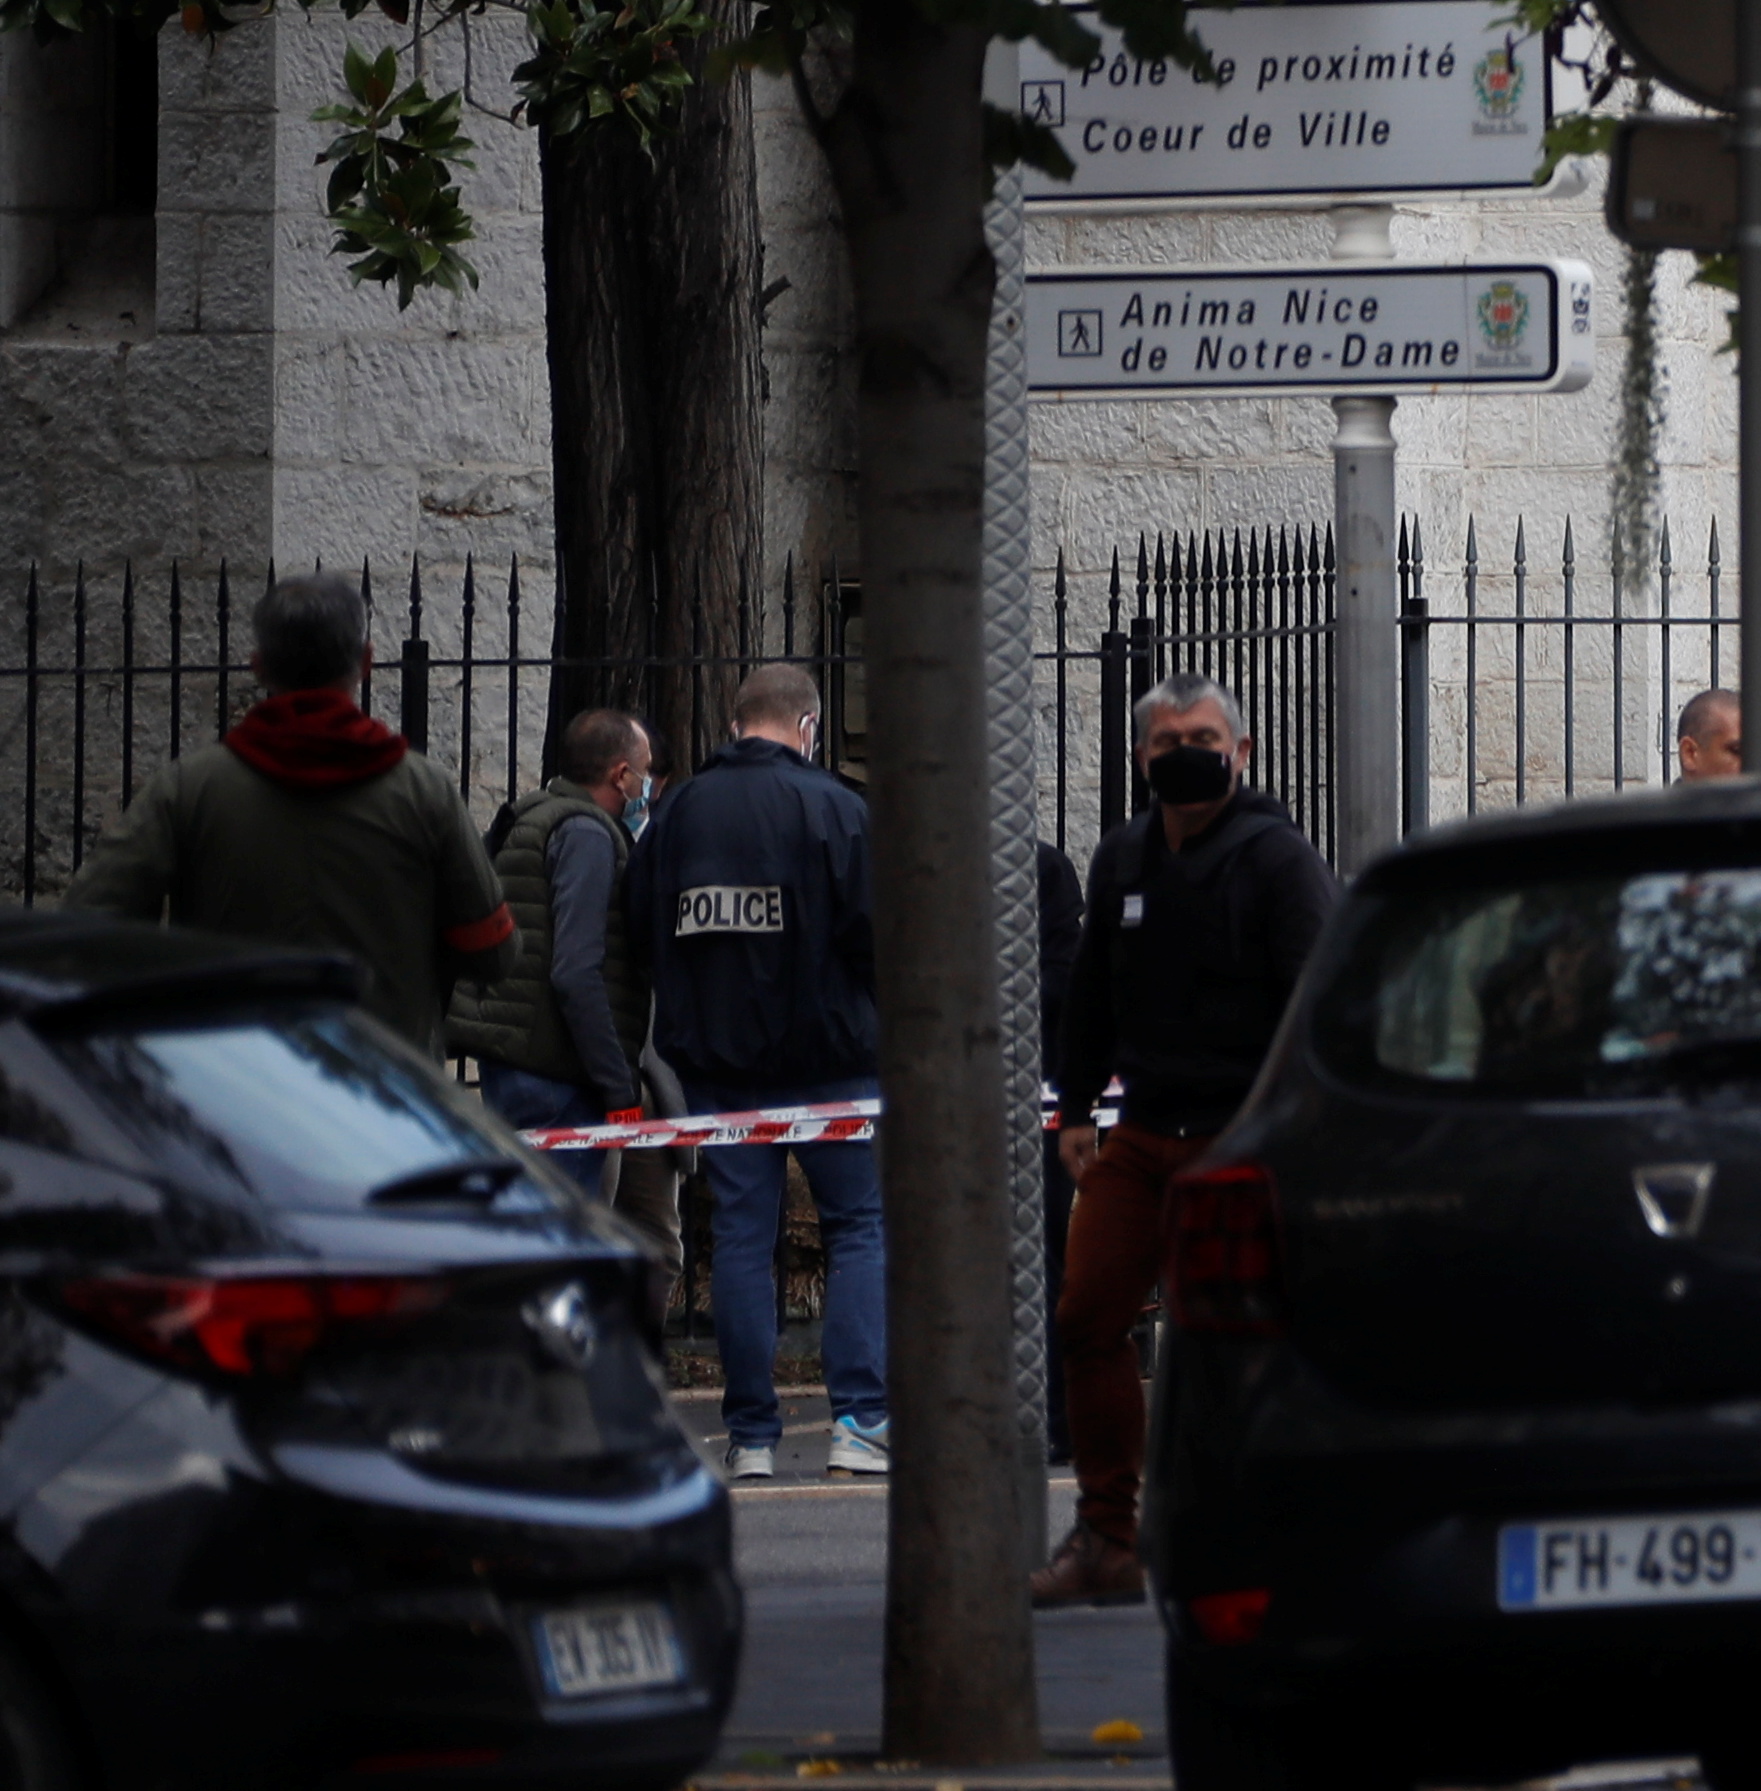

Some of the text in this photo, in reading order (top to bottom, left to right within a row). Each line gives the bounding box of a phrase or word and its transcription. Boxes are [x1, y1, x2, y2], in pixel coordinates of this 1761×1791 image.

[1079, 52, 1169, 88] Pôle
[1256, 41, 1458, 92] proximité
[1081, 110, 1392, 154] Coeur de Ville
[1119, 288, 1380, 328] Anima Nice
[1120, 336, 1168, 372] de
[1194, 332, 1460, 371] Notre-Dame
[677, 891, 781, 932] POLICE
